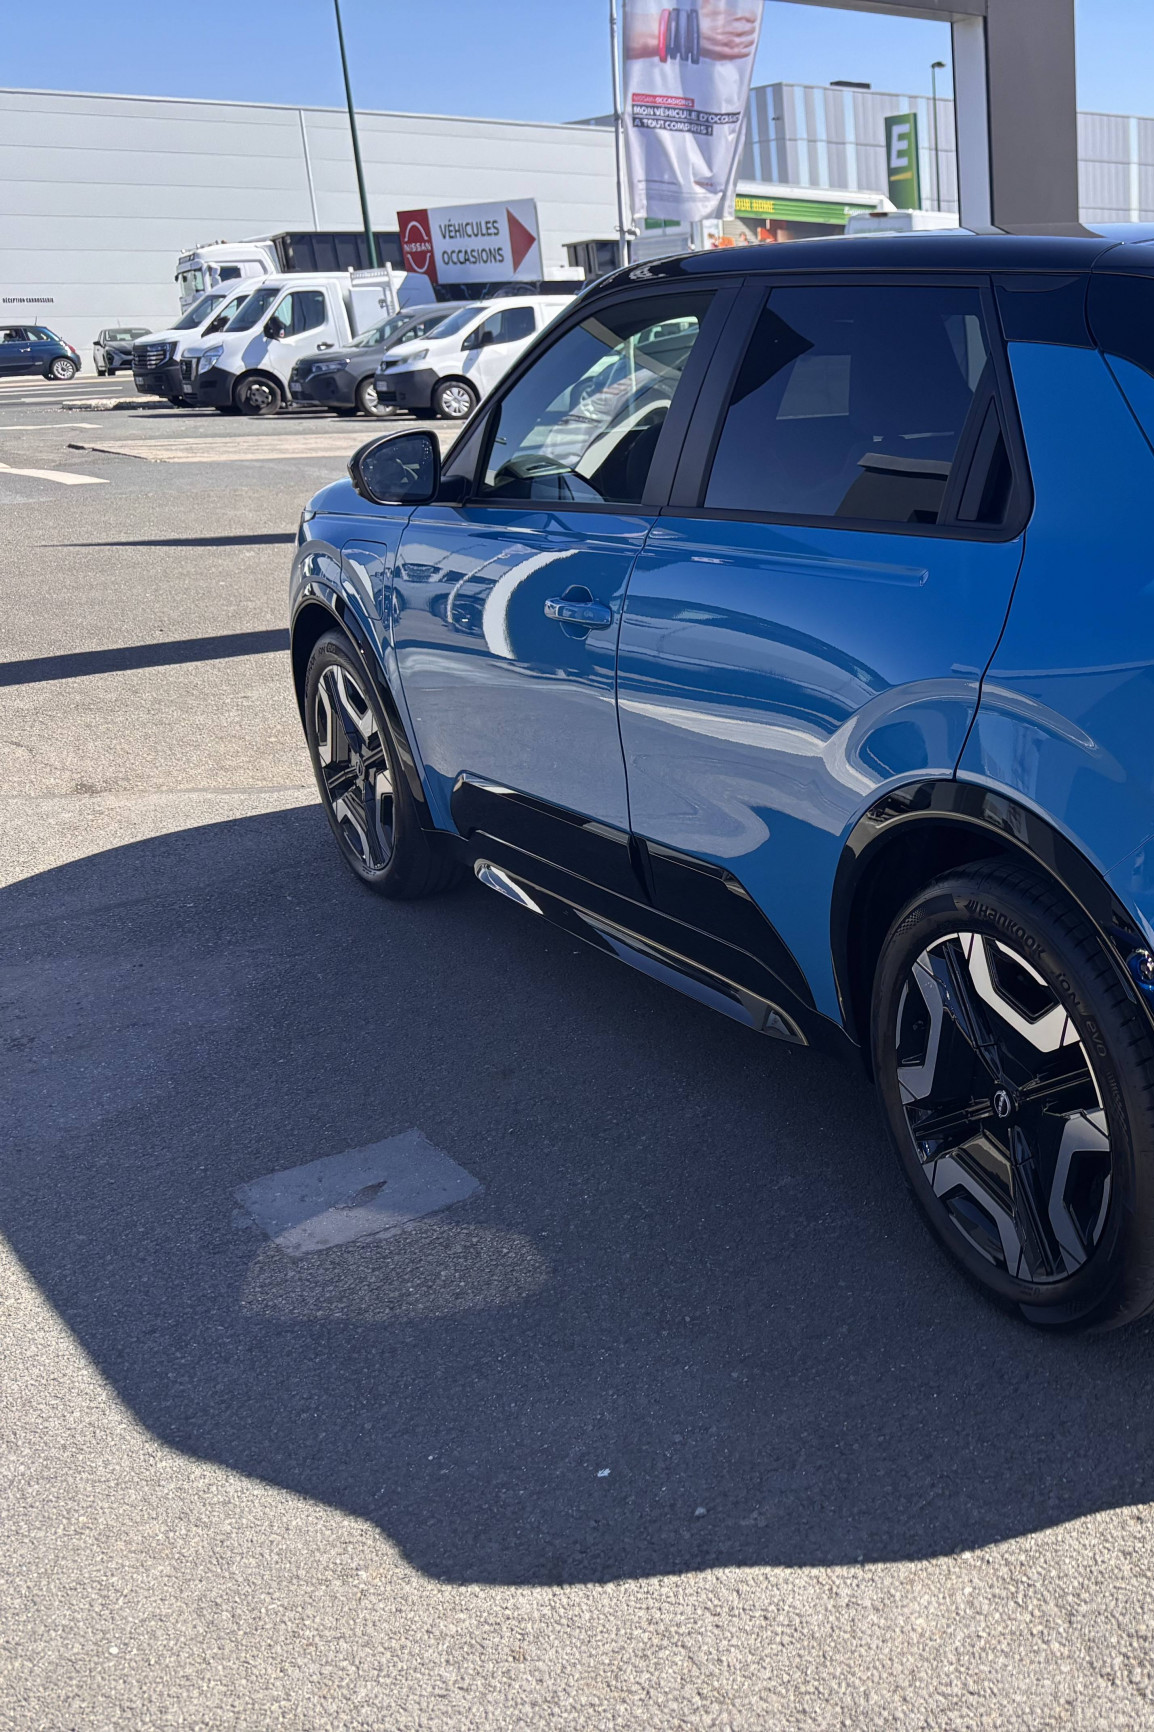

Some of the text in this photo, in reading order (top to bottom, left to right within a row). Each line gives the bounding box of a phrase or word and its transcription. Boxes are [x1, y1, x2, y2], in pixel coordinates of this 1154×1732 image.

[633, 105, 653, 115] MON
[643, 118, 665, 128] TOUT
[665, 121, 707, 134] COMPRIS
[890, 123, 910, 168] E
[438, 219, 500, 240] VÉHICULES
[403, 242, 431, 252] NISSAN
[441, 247, 505, 265] OCCASIONS
